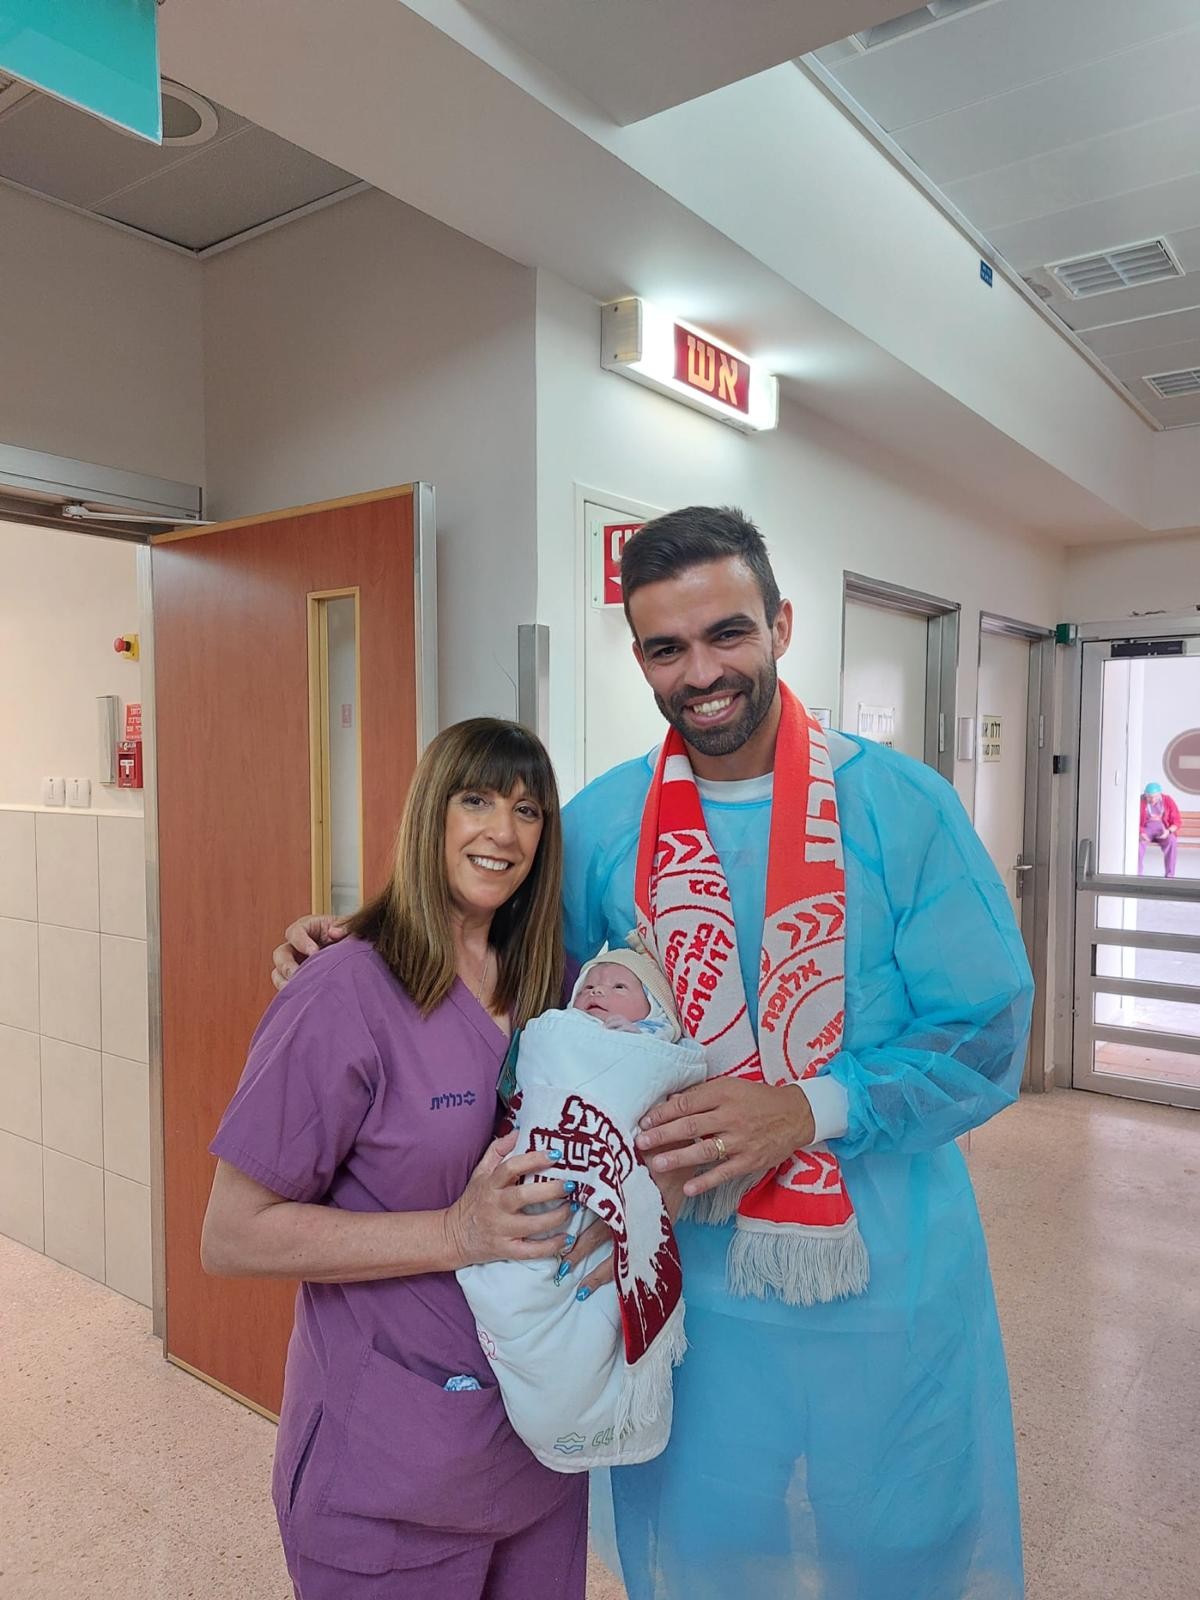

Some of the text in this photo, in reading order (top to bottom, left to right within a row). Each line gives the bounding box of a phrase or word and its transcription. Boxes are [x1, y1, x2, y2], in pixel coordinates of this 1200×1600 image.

[687, 335, 738, 405] אש
[683, 928, 735, 1038] 2016/17
[761, 958, 822, 1033] אלופת
[430, 1092, 463, 1110] כללית
